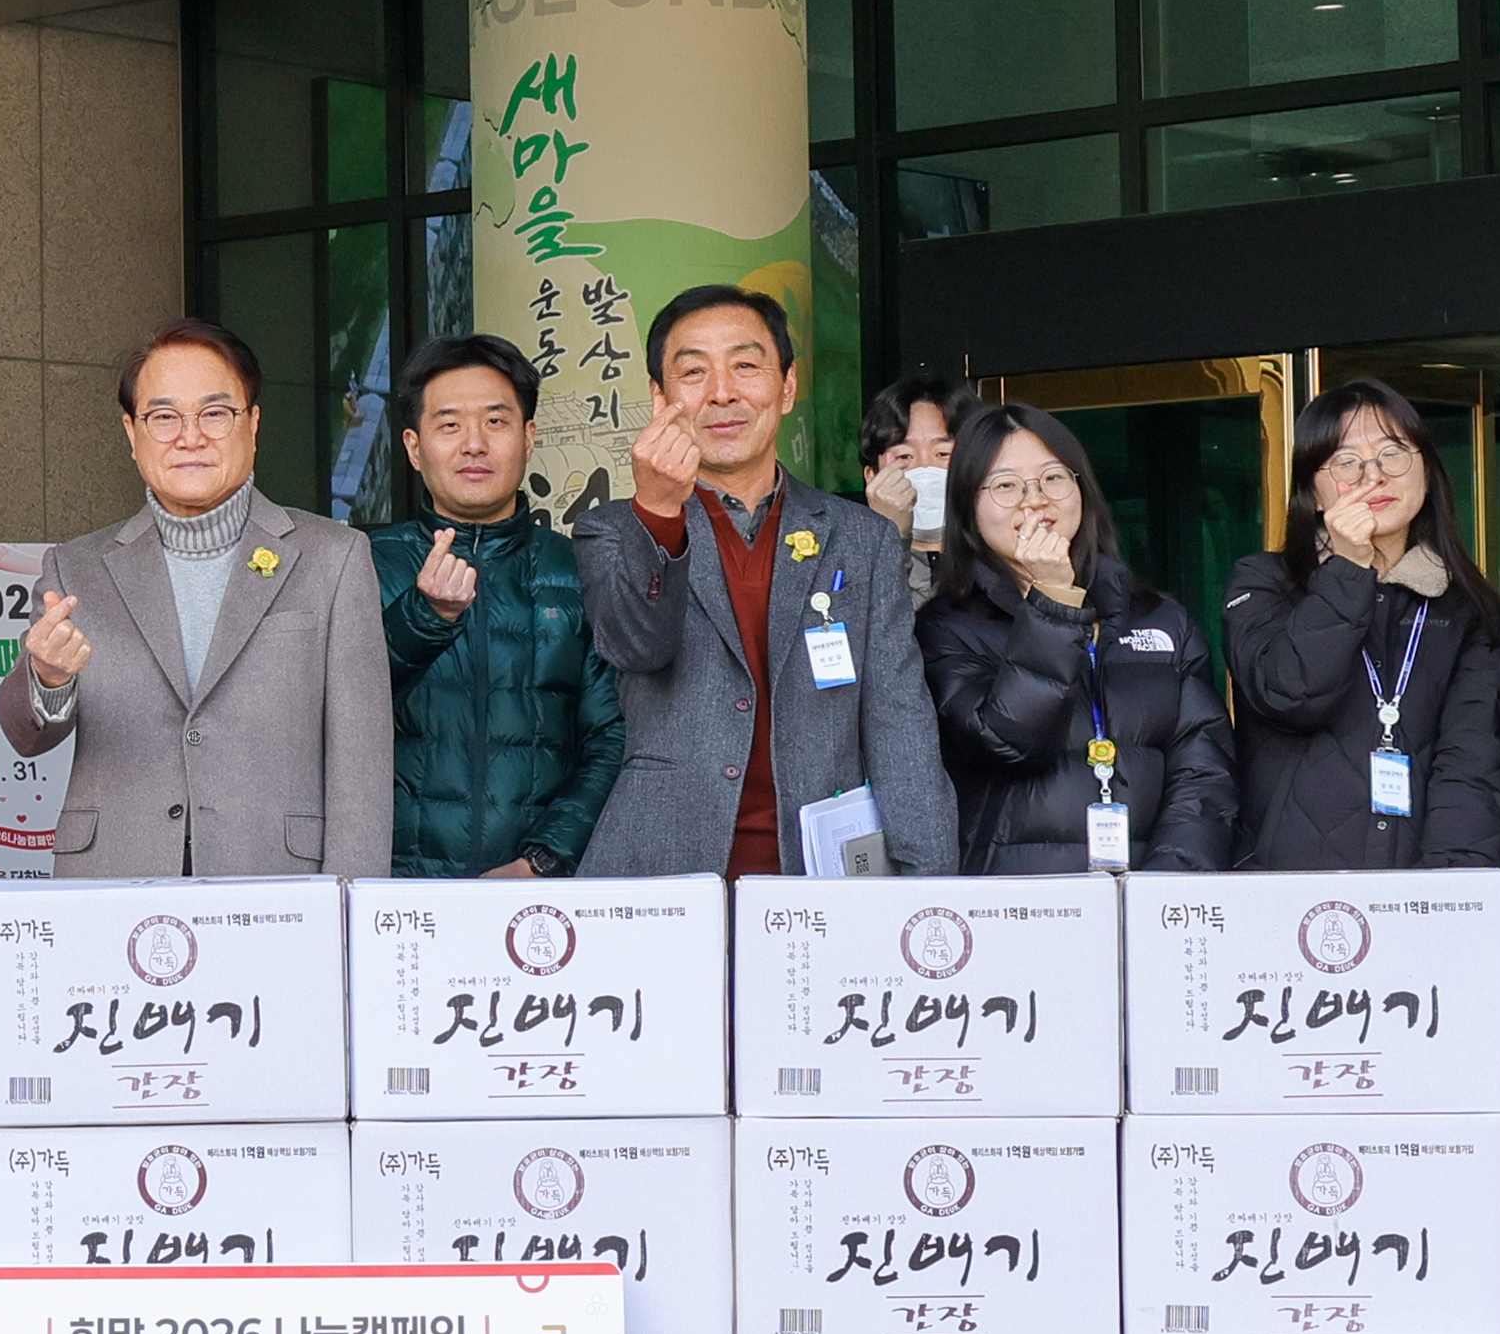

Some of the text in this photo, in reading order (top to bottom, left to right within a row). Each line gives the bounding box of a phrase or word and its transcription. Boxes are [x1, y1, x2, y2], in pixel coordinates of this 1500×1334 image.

[500, 52, 605, 264] 새마을
[528, 277, 567, 379] 운동
[578, 273, 631, 429] 발상지
[1119, 636, 1153, 645] NORTH
[1132, 643, 1157, 652] FACE
[13, 761, 48, 782] 31.
[374, 909, 436, 939] (주)가득
[608, 906, 633, 919] 1억원
[764, 908, 827, 938] (주)가득
[1160, 903, 1225, 933] (주)가득
[53, 998, 259, 1055] 진배기
[433, 989, 642, 1047] 진배기
[824, 990, 1036, 1048] 진배기
[1223, 986, 1438, 1045] 진배기
[113, 1066, 197, 1095] 간장
[494, 1061, 580, 1091] 간장
[885, 1062, 973, 1092] 간장
[1287, 1058, 1376, 1089] 간장
[8, 1148, 70, 1177] (주)가득
[378, 1150, 442, 1181] (주)가득
[767, 1146, 830, 1176] (주)가득
[1150, 1143, 1215, 1174] (주)가득
[826, 1228, 1040, 1287] 진배기
[1213, 1227, 1433, 1291] 진배기
[888, 1302, 976, 1332] 간장
[1277, 1302, 1367, 1333] 간장
